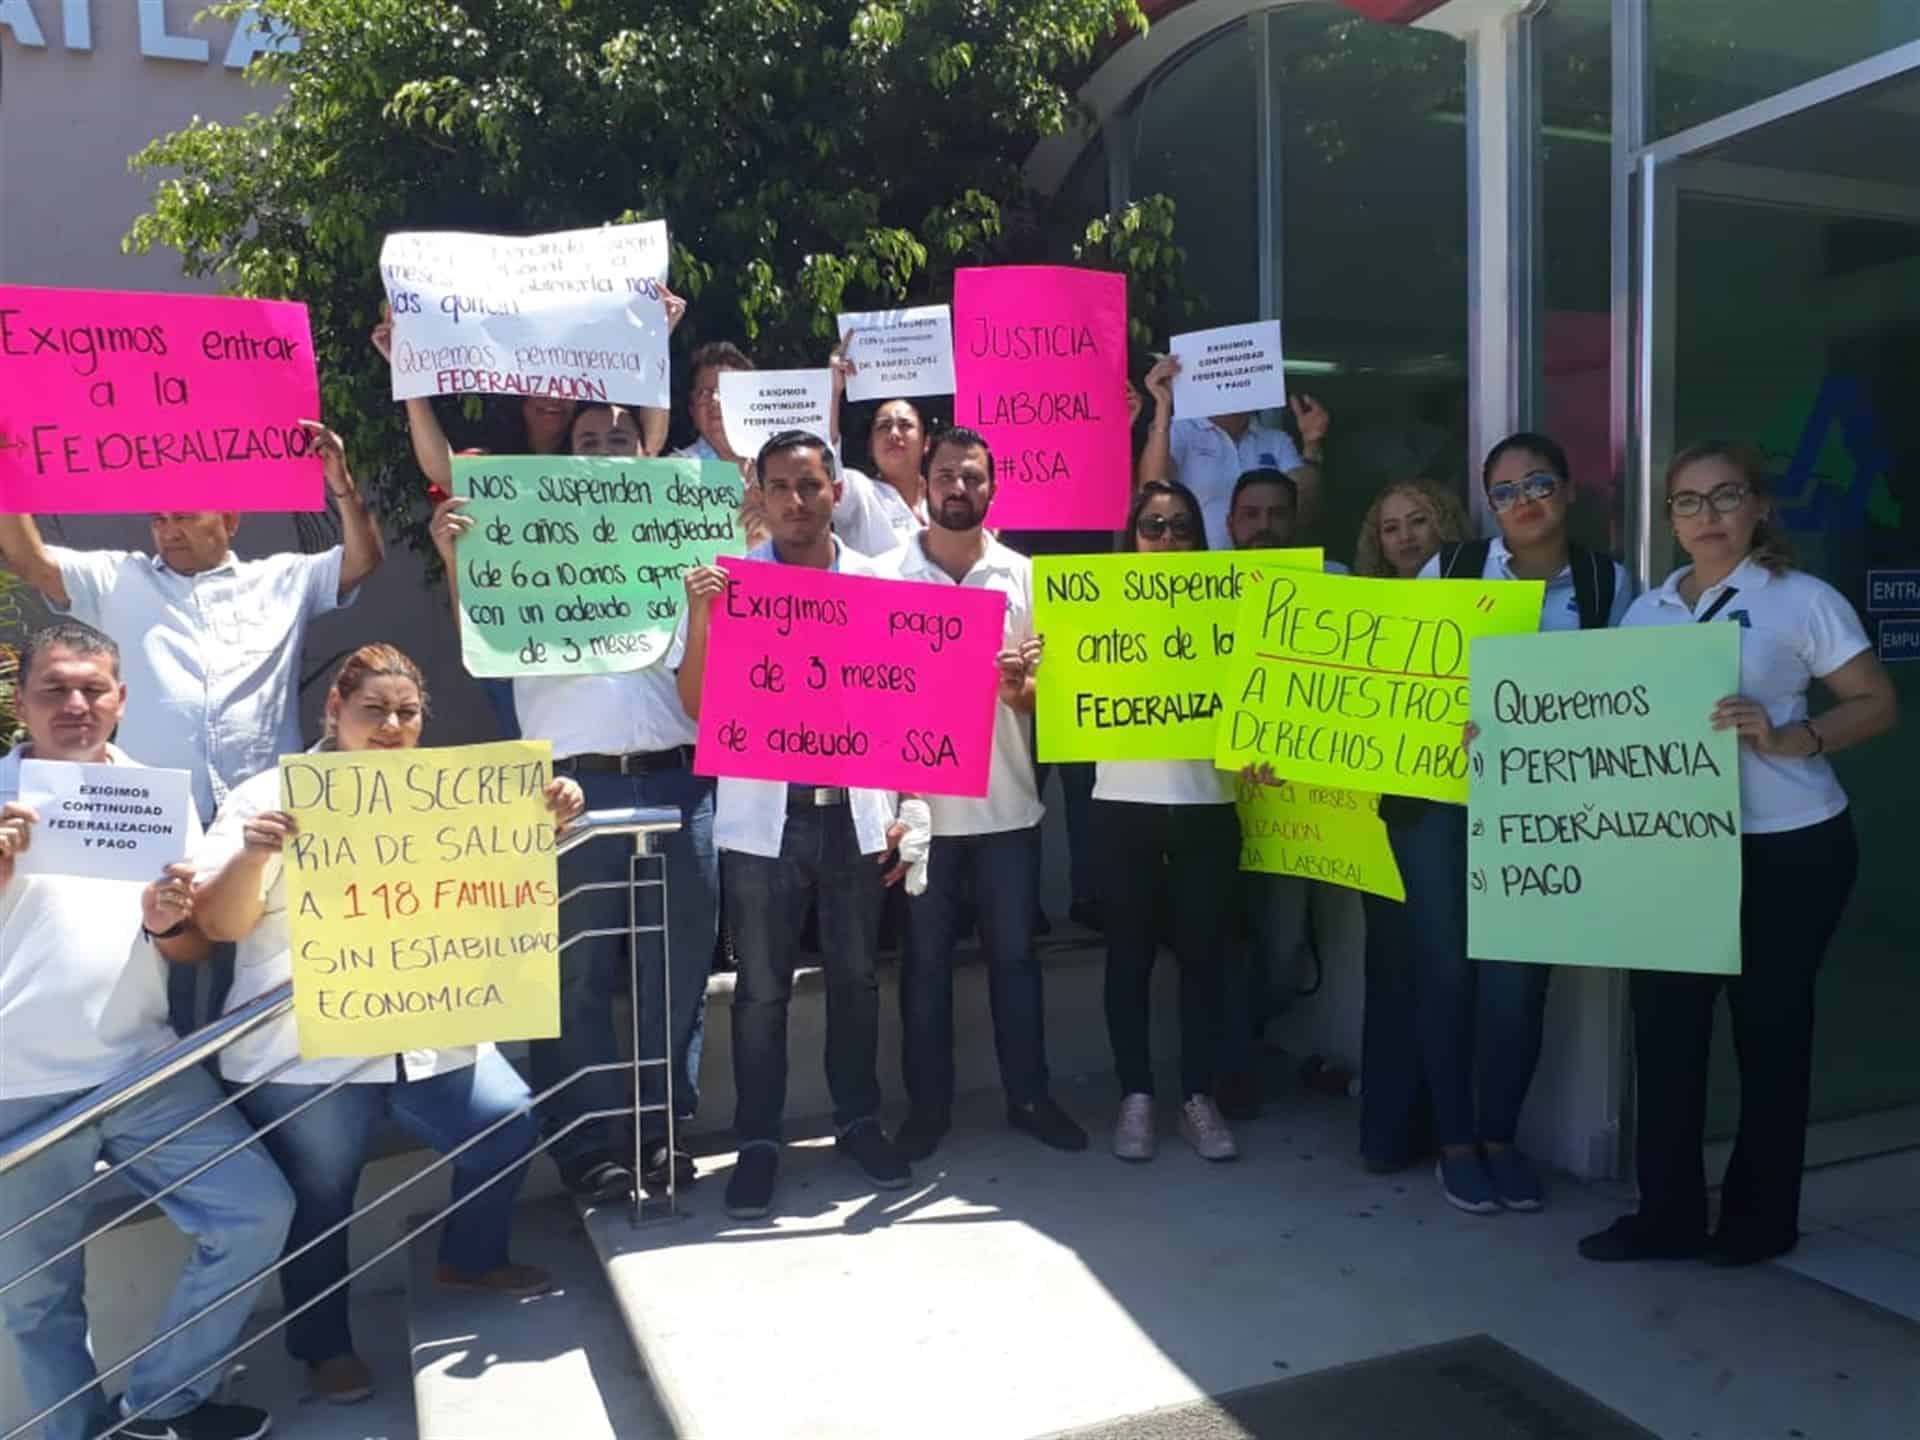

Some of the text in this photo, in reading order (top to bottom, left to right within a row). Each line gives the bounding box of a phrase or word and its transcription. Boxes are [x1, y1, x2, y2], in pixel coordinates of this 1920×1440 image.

[0, 310, 300, 376] Exigimos entrar
[399, 341, 496, 374] Queremos
[515, 342, 642, 371] permanencia
[970, 318, 1098, 360] JUSTICIA
[1198, 350, 1265, 367] CONTINUIDAD
[90, 371, 189, 407] a la
[1225, 379, 1251, 389] PAGO
[977, 391, 1100, 426] LABORAL
[997, 449, 1071, 483] #SSA
[469, 472, 740, 511] NOS suspenden despues
[486, 516, 513, 545] de
[523, 517, 579, 544] años
[592, 515, 617, 544] de
[511, 560, 531, 588] 6
[1045, 569, 1100, 603] NOS
[1873, 580, 1920, 601] ENTR
[469, 603, 505, 626] con
[519, 604, 544, 625] un
[555, 595, 632, 622] adeudo
[726, 579, 963, 653] Exigimos pago
[519, 633, 652, 665] de 3 meses
[1076, 622, 1235, 664] antes de la
[750, 655, 917, 694] de 3 meses
[1241, 667, 1268, 705] A
[1075, 692, 1223, 729] FEDERALIZA
[1493, 678, 1651, 725] Queremos
[717, 718, 960, 768] de adeudo SSA
[1231, 709, 1385, 771] DERECHOS
[1500, 741, 1721, 786] PERMANENCIA
[79, 784, 150, 798] EXIGIMOS
[284, 760, 546, 817] DEJA SECRETA
[48, 819, 173, 835] FEDERALIZACION
[62, 801, 163, 816] CONTINUIDAD
[83, 838, 137, 849] Y PAGO
[290, 823, 557, 872] RIA DE SALUD
[1281, 848, 1369, 887] LABORAL
[1501, 863, 1583, 897] PAGO
[299, 890, 323, 920] A
[434, 880, 557, 909] FAMILIAS
[301, 932, 559, 975] SIN ESTABILIDAD
[318, 983, 505, 1021] ECONOMICA
